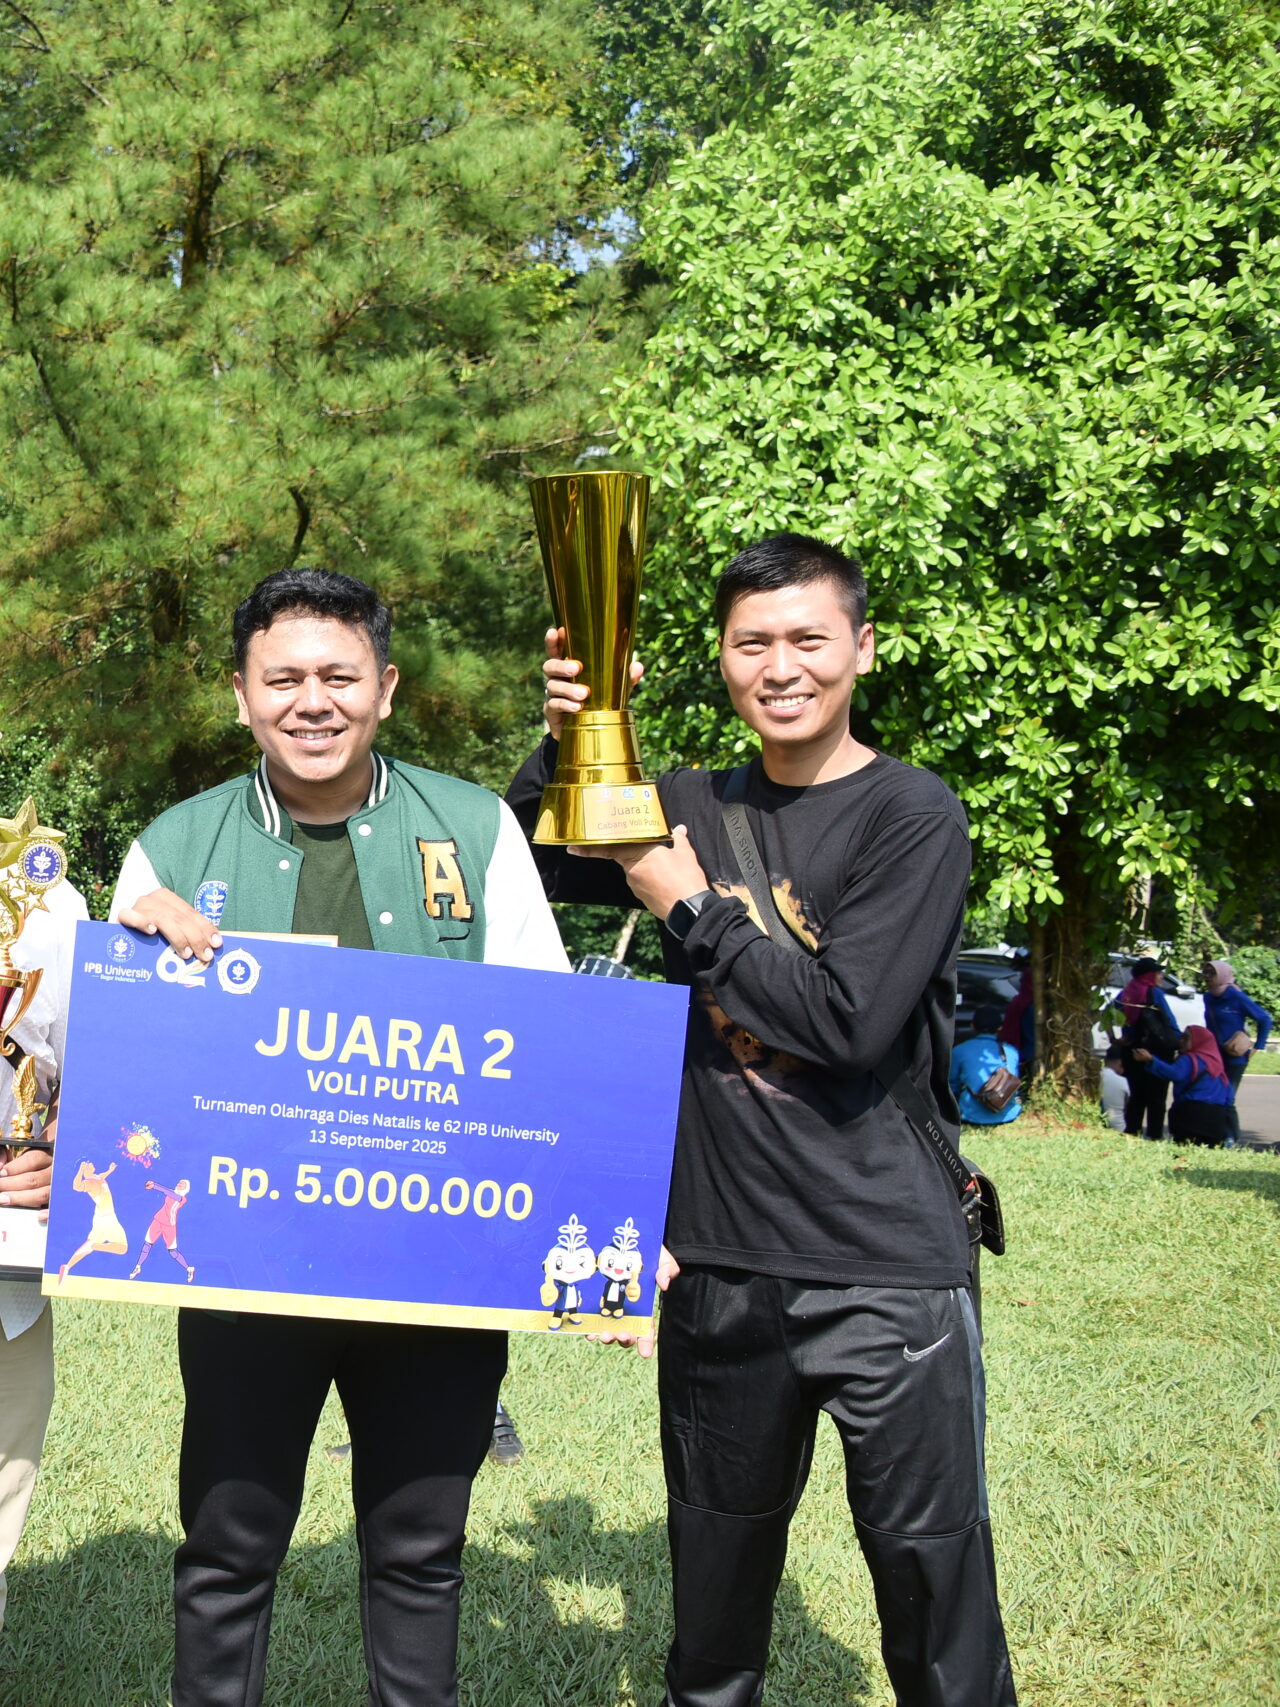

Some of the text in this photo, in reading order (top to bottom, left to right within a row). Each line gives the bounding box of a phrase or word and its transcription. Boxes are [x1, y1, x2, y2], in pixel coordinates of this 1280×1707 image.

[597, 820, 627, 831] Cabang
[629, 819, 643, 827] Voli
[611, 805, 650, 816] Juara 2
[415, 837, 474, 923] A
[84, 961, 153, 982] IPB University
[254, 1007, 514, 1079] JUARA 2
[307, 1069, 459, 1105] VOLI PUTRA
[193, 1096, 559, 1145] Turnamen Olahraga Dies Natalis ke 62 IPB University
[309, 1130, 447, 1154] 13 September 2025
[926, 1120, 962, 1179] VUITTON
[208, 1156, 533, 1221] Rp. 5.000.000
[2, 1230, 7, 1242] 1
